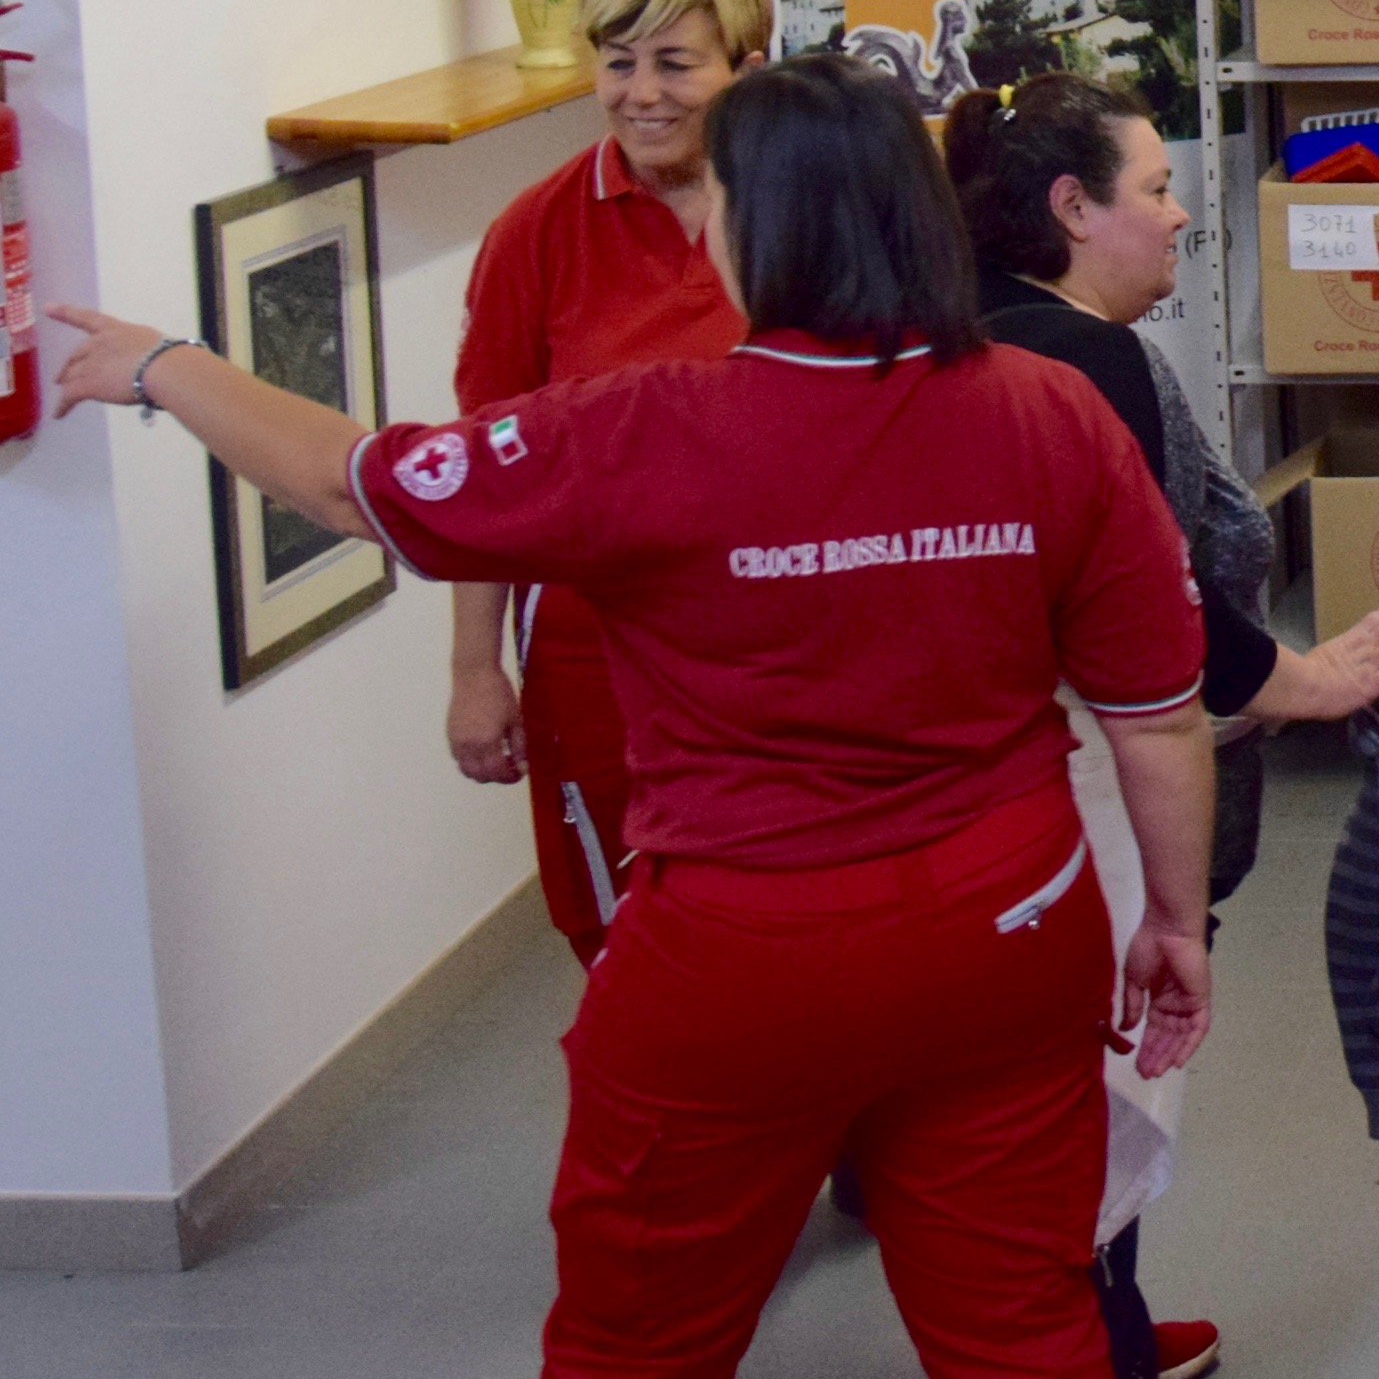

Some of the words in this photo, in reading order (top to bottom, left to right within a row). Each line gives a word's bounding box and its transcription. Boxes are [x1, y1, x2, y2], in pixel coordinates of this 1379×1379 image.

[1308, 28, 1349, 41] Croce
[1301, 214, 1357, 233] 3071
[1303, 240, 1357, 258] 3140
[1314, 340, 1354, 352] Croce
[729, 542, 819, 578] CROCE
[822, 532, 907, 573] ROSSA
[910, 522, 1035, 562] ITALIANA
